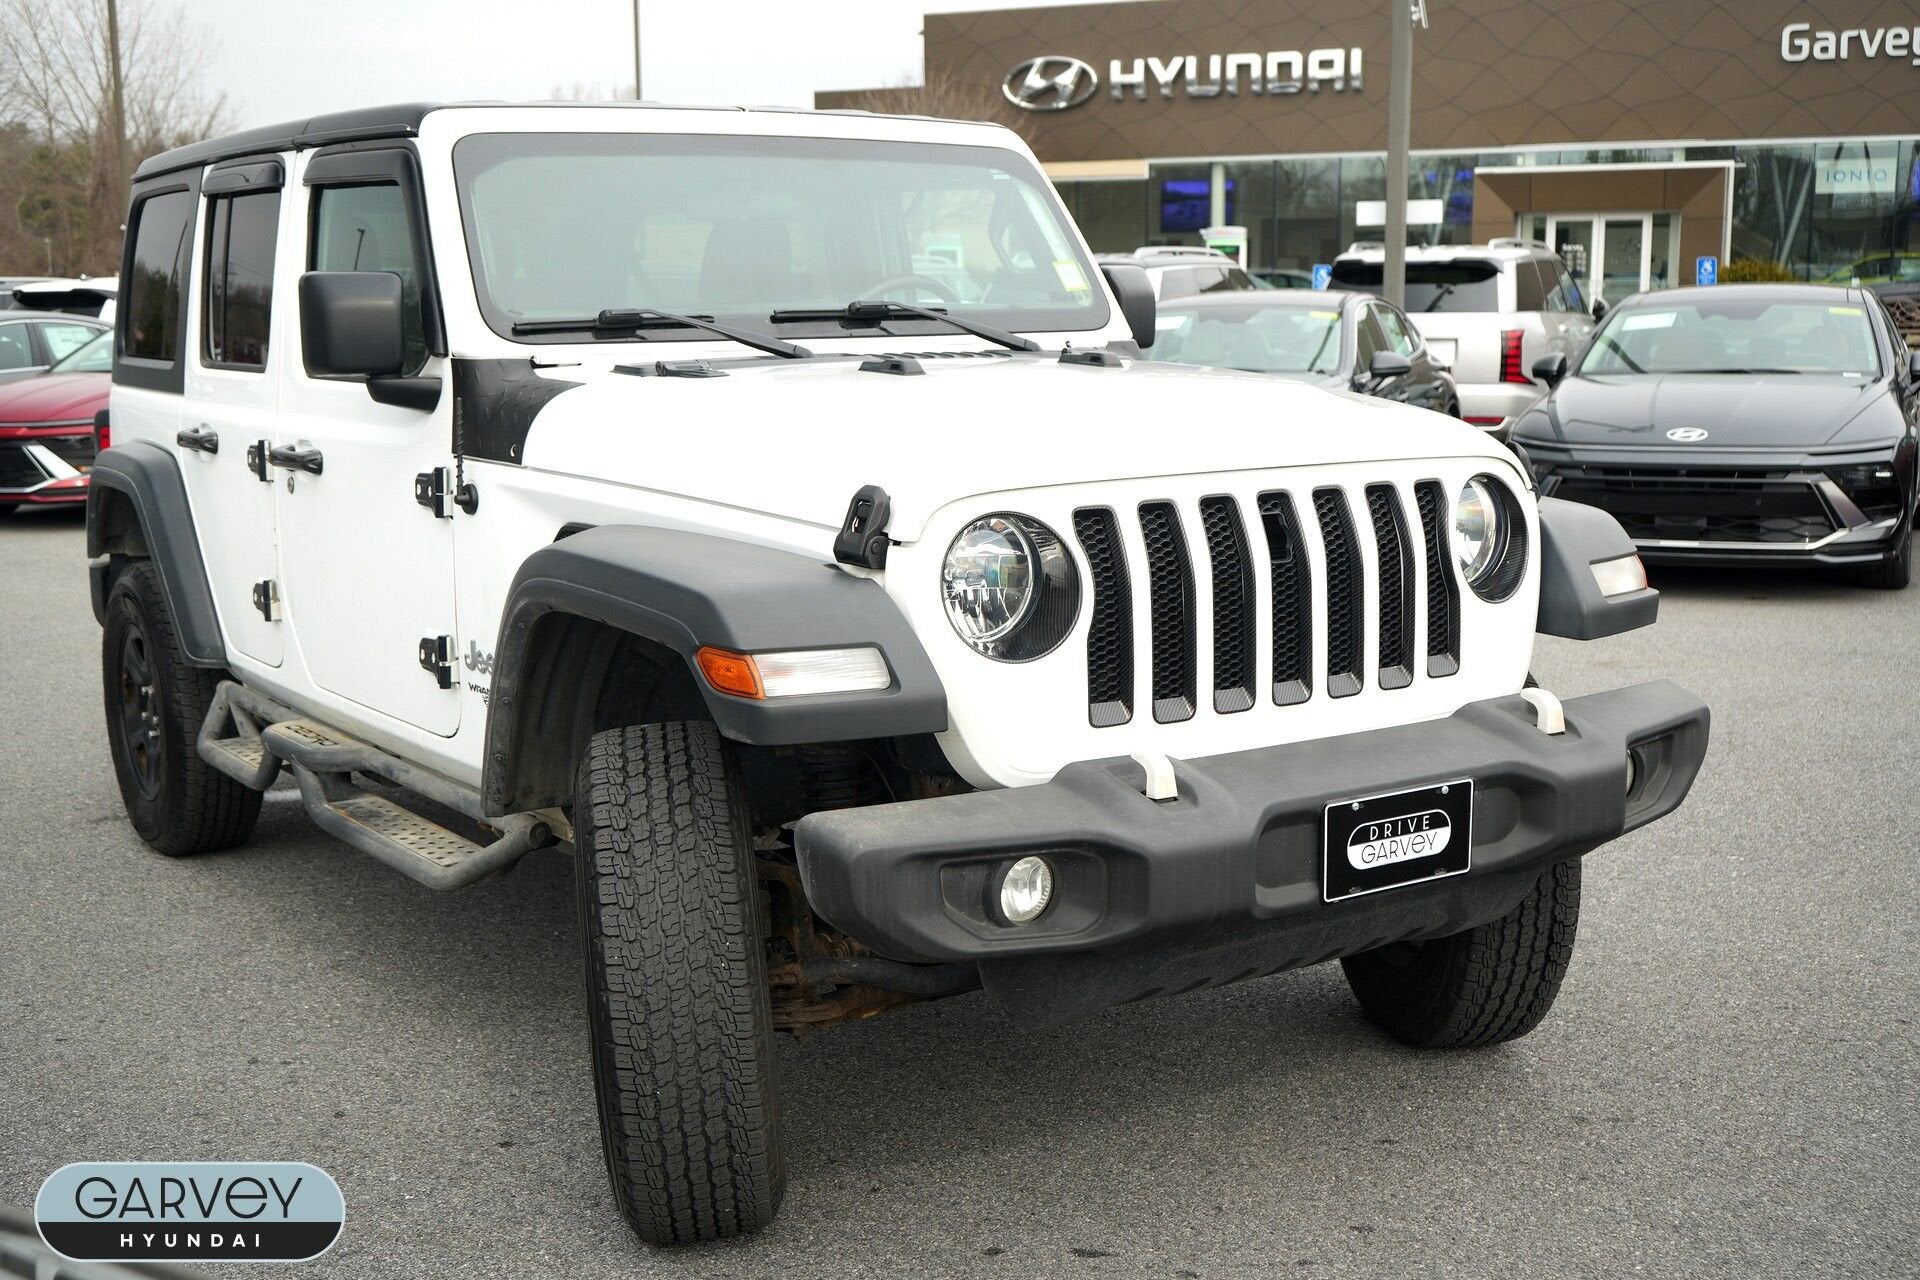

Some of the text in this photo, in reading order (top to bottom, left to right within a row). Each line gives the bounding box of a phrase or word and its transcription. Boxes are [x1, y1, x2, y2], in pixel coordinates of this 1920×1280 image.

[1109, 46, 1364, 101] HYUNDAI
[1825, 168, 1888, 183] IONIQ
[464, 640, 495, 675] Jee
[1369, 815, 1430, 840] DRIVE
